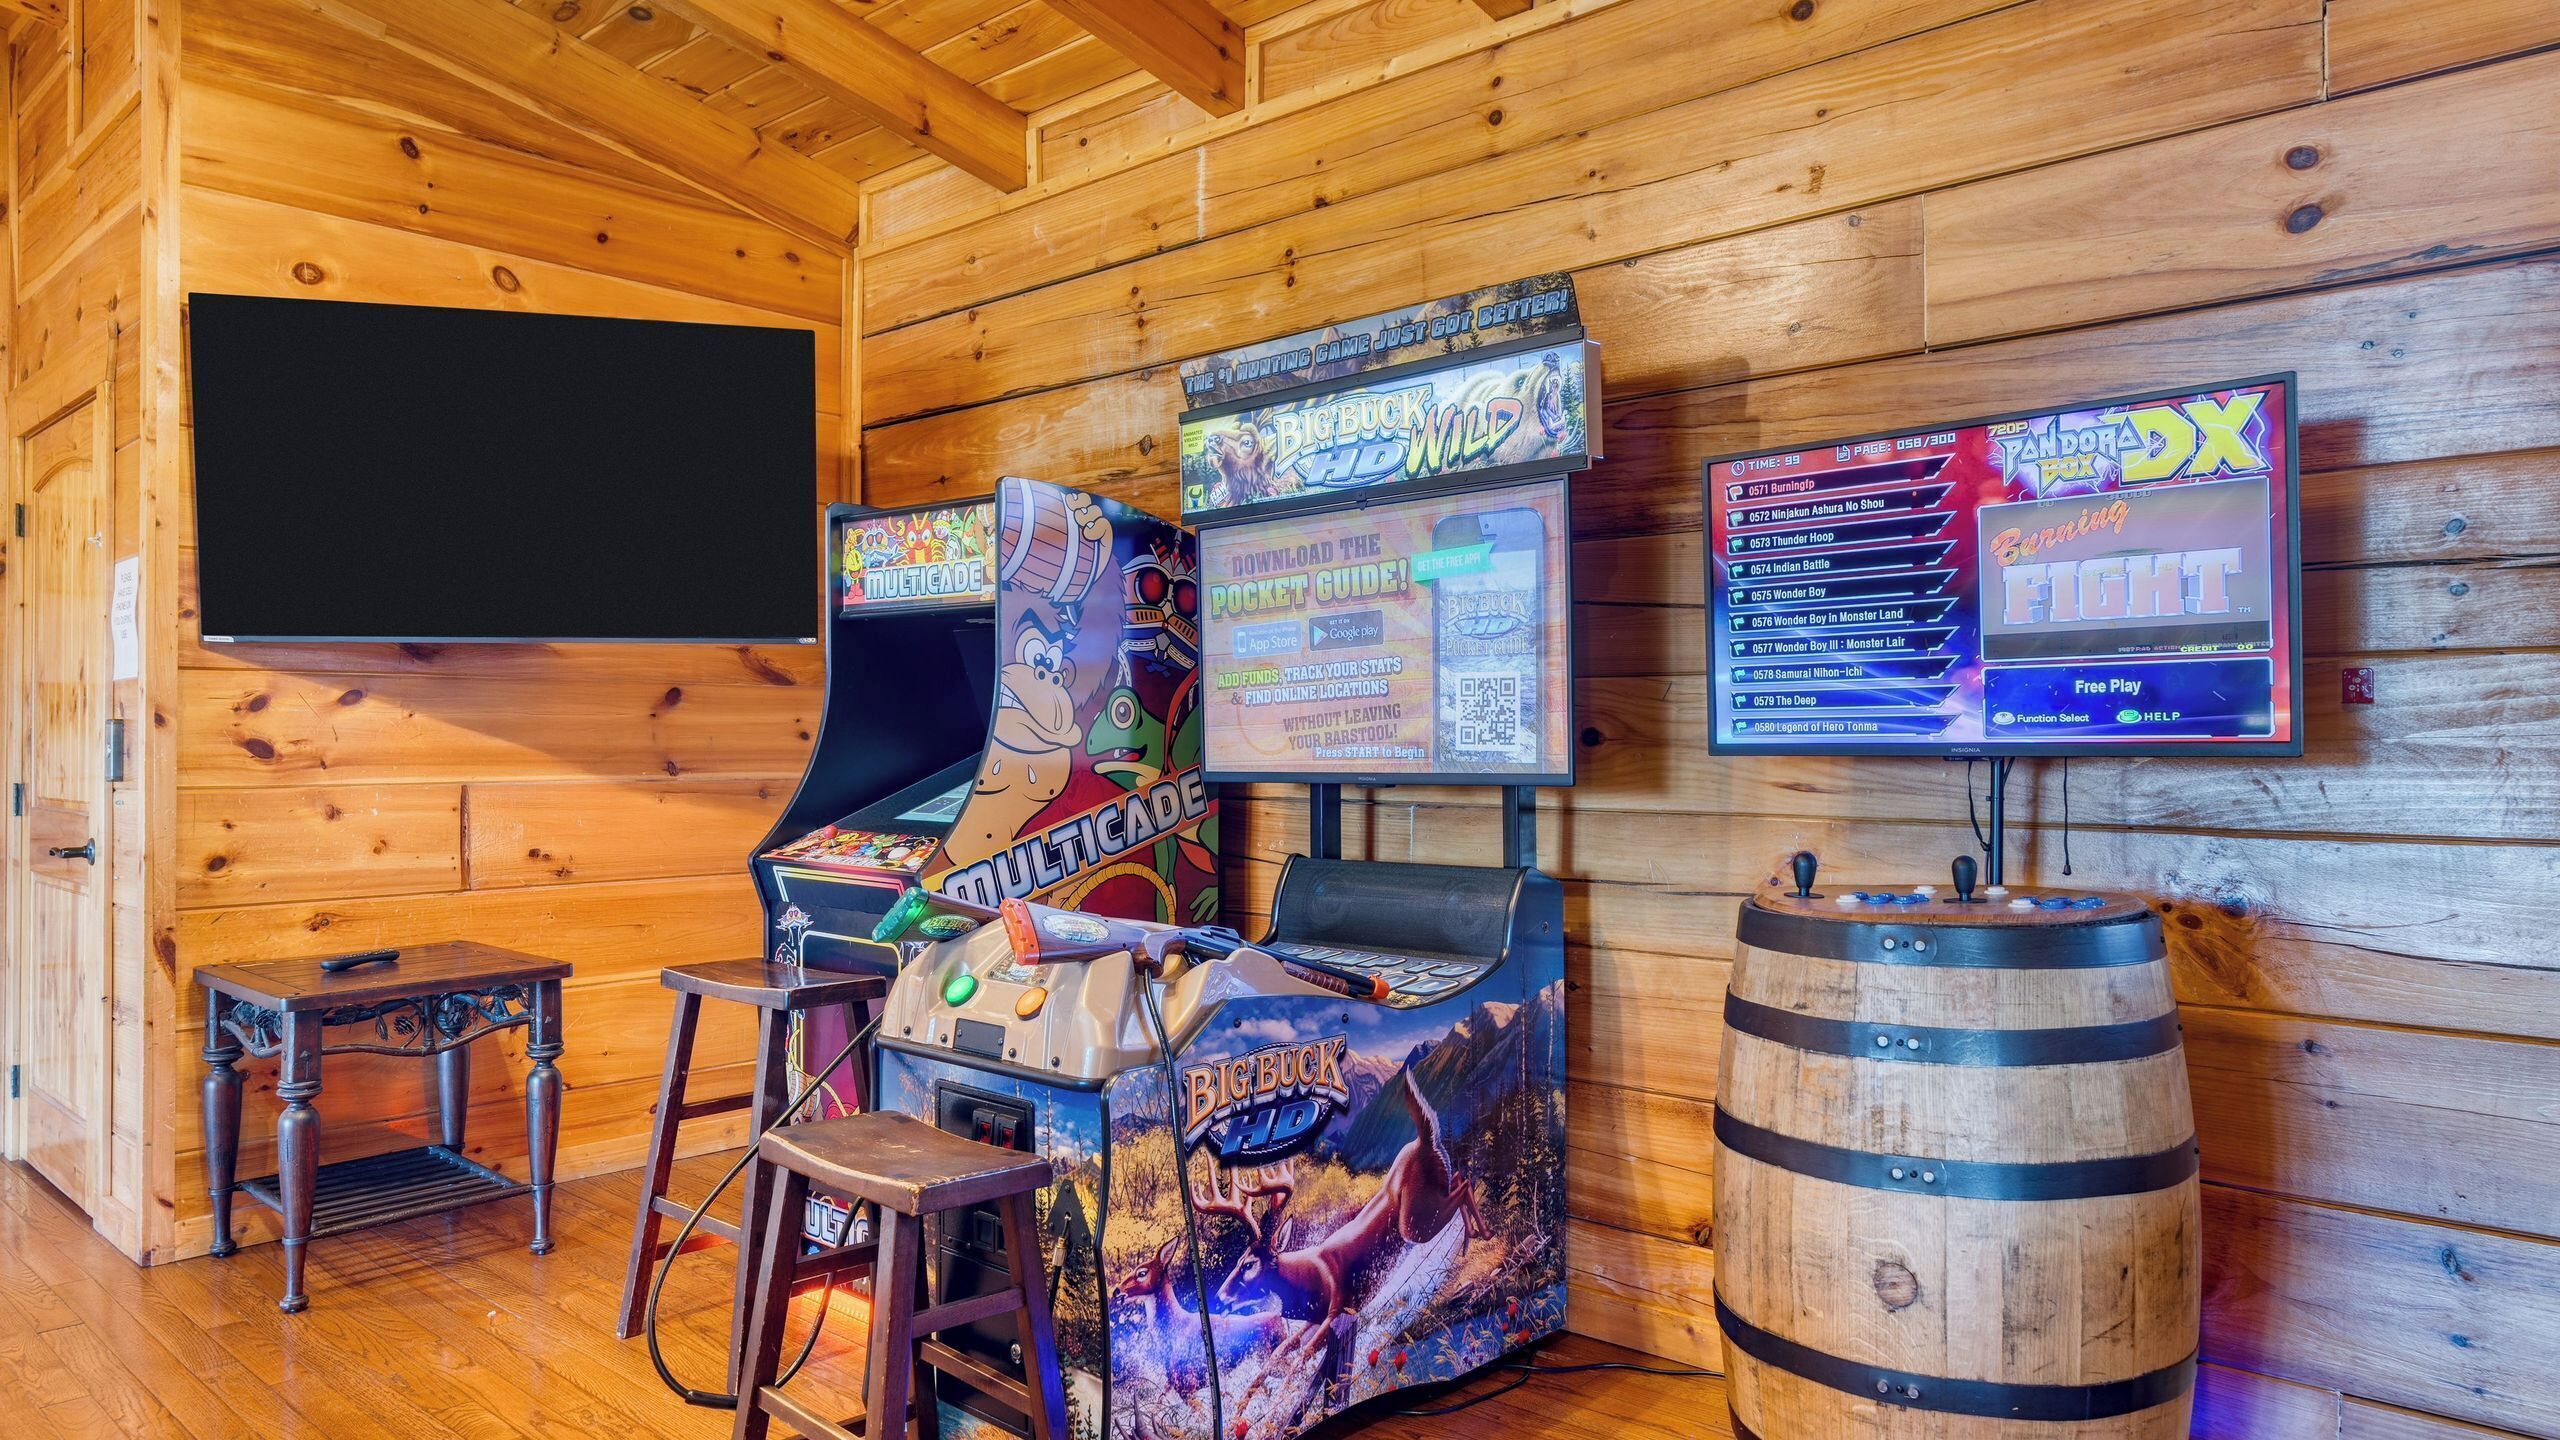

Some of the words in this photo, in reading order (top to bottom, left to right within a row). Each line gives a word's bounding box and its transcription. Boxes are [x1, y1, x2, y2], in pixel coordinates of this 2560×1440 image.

[1185, 373, 1215, 395] THE
[1218, 367, 1233, 386] #1
[1236, 348, 1312, 384] HUNTING
[1315, 334, 1371, 365] GAME
[1374, 321, 1428, 353] JUST
[1430, 310, 1474, 340] GOT
[1477, 289, 1569, 330] BETTER!
[1275, 405, 1334, 463] BIG
[1337, 384, 1433, 440] BUCK
[1987, 421, 2029, 437] 720P
[1304, 442, 1406, 485] HD
[1405, 397, 1523, 478] WILD
[1854, 443, 1892, 456] PAGE:
[1995, 415, 2146, 486] PANDORA
[2037, 454, 2102, 498] BOX
[2103, 390, 2273, 486] DX
[1748, 458, 1781, 471] TIME:
[1785, 455, 1800, 466] 99
[1748, 484, 1769, 496] 0571
[1771, 479, 1815, 494] Burningfp
[1749, 511, 1770, 523] 0572
[1771, 506, 1810, 522] Ninjakun
[1812, 502, 1844, 515] Ashura
[1845, 500, 1859, 512] No
[1860, 498, 1885, 511] Shou
[1750, 537, 1771, 549] 0573
[1772, 533, 1808, 547] Thunder
[1810, 531, 1834, 545] Hoop
[1989, 500, 2130, 567] Burning
[1232, 541, 1334, 577] DOWNLOAD
[1340, 533, 1381, 560] THE
[1751, 564, 1772, 575] 0574
[1773, 560, 1801, 574] Indian
[1803, 558, 1830, 570] Battle
[865, 561, 983, 601] MULTICADE
[1210, 572, 1310, 619] POCKET
[1315, 557, 1410, 605] GUIDE!
[2002, 548, 2243, 625] FIGHT
[1478, 591, 1528, 615] BUCK
[1751, 589, 1773, 601] 0575
[1773, 587, 1807, 600] Wonder
[1809, 586, 1827, 599] Boy
[1461, 618, 1514, 636] HD
[1752, 616, 1773, 628] 0576
[1774, 613, 1808, 626] Wonder
[1809, 612, 1827, 626] Boy
[1828, 611, 1838, 623] in
[1839, 610, 1877, 623] Monster
[1879, 607, 1904, 620] Land
[1329, 626, 1361, 641] Google
[1361, 624, 1379, 639] play
[1250, 638, 1269, 652] App
[1270, 635, 1297, 649] Store
[1446, 637, 1493, 656] POCKET
[1494, 635, 1529, 655] GUIDE
[1752, 641, 1774, 654] 0577
[1774, 640, 1808, 653] Wonder
[1809, 639, 1828, 652] Boy
[1846, 637, 1884, 650] Monster
[1886, 636, 1905, 648] Lair
[2180, 645, 2219, 653] CREDIT
[1217, 672, 1241, 690] ADD
[1241, 668, 1284, 688] FUNDS,
[1285, 664, 1325, 683] TRACK
[1325, 660, 1359, 680] YOUR
[1361, 655, 1403, 676] STATS
[1753, 668, 1774, 680] 0578
[1775, 667, 1812, 679] Samurai
[1231, 691, 1244, 706] &
[1244, 688, 1273, 707] FIND
[1274, 684, 1318, 704] ONLINE
[1318, 679, 1389, 701] LOCATIONS
[2075, 679, 2107, 694] Free
[2110, 678, 2142, 696] Play
[1754, 695, 1775, 706] 0579
[1775, 695, 1792, 706] The
[1794, 695, 1817, 707] Deep
[1282, 711, 1342, 733] WITHOUT
[1344, 703, 1401, 726] LEAVING
[2017, 714, 2058, 723] Function
[2059, 713, 2090, 723] Select
[2144, 712, 2181, 721] HELP
[1288, 732, 1321, 752] YOUR
[1324, 724, 1399, 747] BARSTOOL!
[1754, 721, 1775, 733] 0580
[1776, 721, 1808, 734] Legend
[1810, 721, 1820, 732] of
[1822, 721, 1844, 732] Hero
[1846, 721, 1878, 732] Tonma
[1314, 745, 1343, 759] Press
[1345, 744, 1380, 758] START
[1381, 745, 1393, 758] to
[1394, 744, 1426, 761] Begin
[942, 770, 1209, 908] MULTICADE
[1184, 1058, 1251, 1134] BIG
[1256, 1037, 1348, 1097] BUCK
[1220, 1100, 1320, 1156] HD
